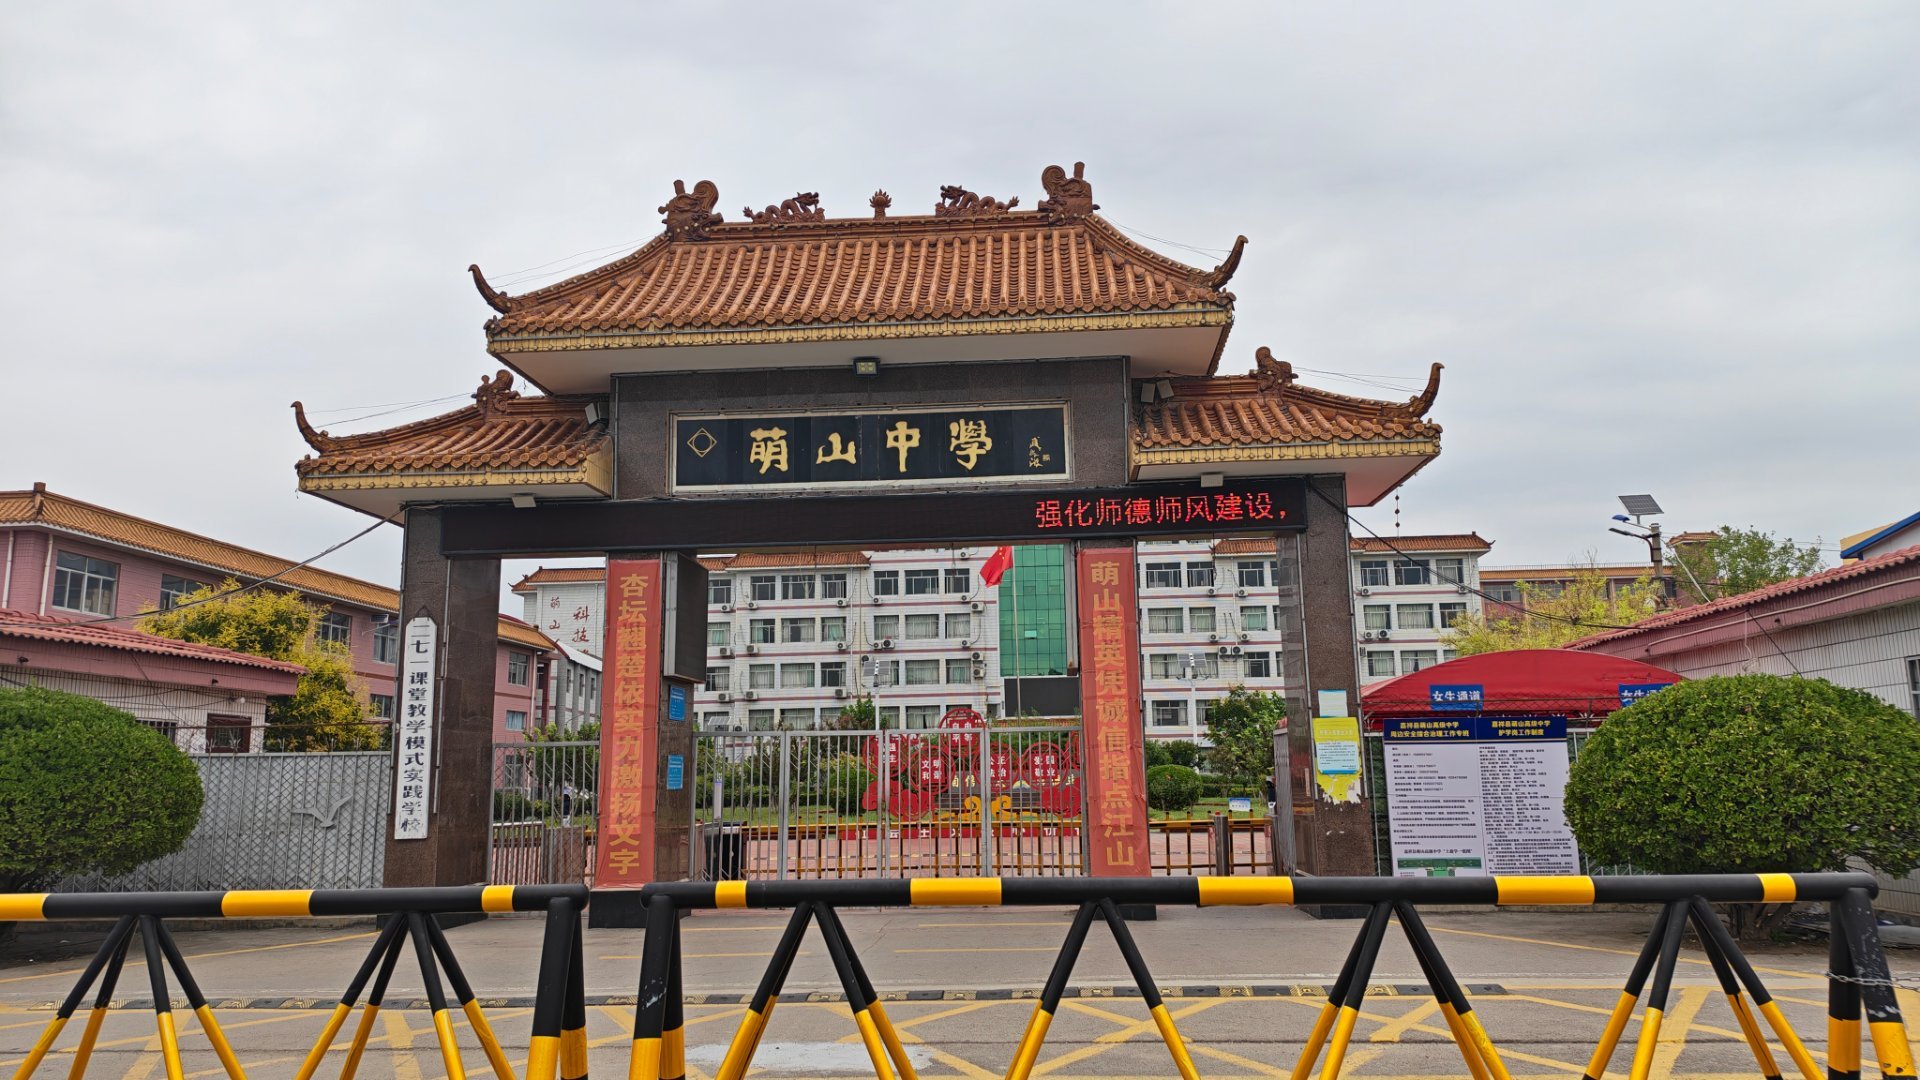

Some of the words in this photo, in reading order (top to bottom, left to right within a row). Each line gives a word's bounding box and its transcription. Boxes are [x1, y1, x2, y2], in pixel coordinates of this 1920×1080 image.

[750, 418, 993, 474] 萌山中學
[572, 606, 590, 654] 科技
[401, 625, 431, 833] 二七一课堂教学模式实践学校
[1090, 561, 1134, 867] 萌山精英凭诚信指点江山
